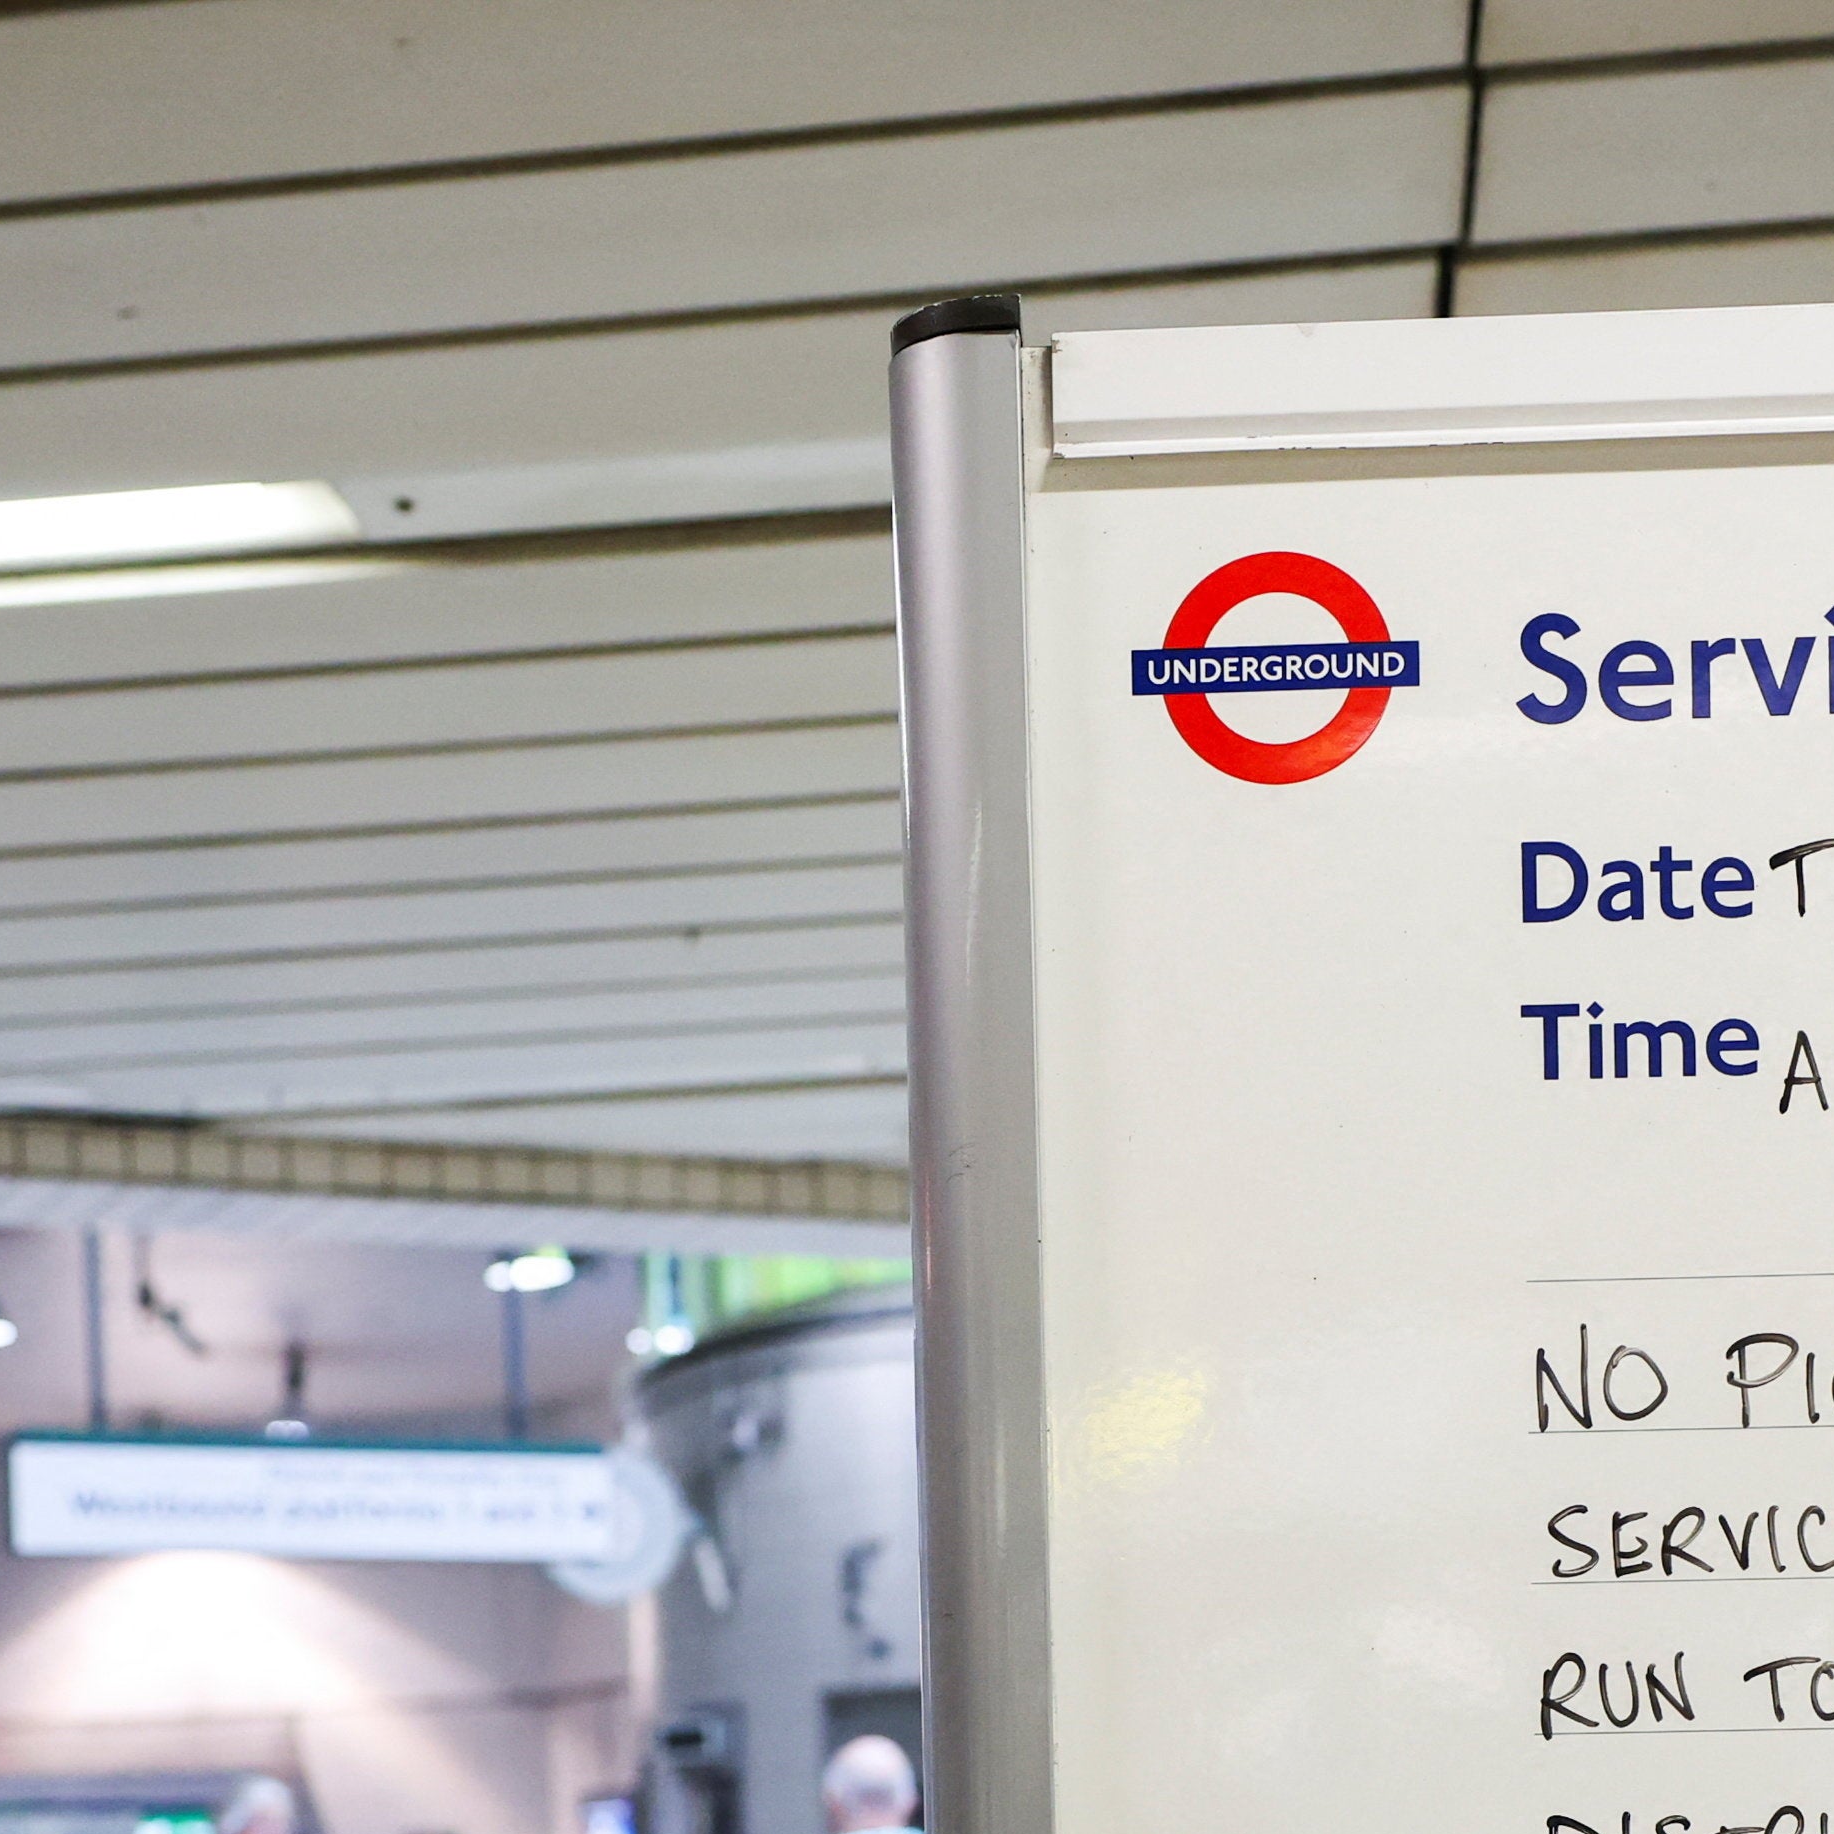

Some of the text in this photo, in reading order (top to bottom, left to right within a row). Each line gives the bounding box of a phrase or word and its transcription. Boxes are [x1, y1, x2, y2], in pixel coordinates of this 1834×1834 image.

[1148, 652, 1405, 685] UNDERGROUND
[1519, 839, 1756, 925] Date
[1519, 999, 1761, 1082] Time
[1527, 1322, 1670, 1435] NO
[1533, 1649, 1704, 1743] RUN
